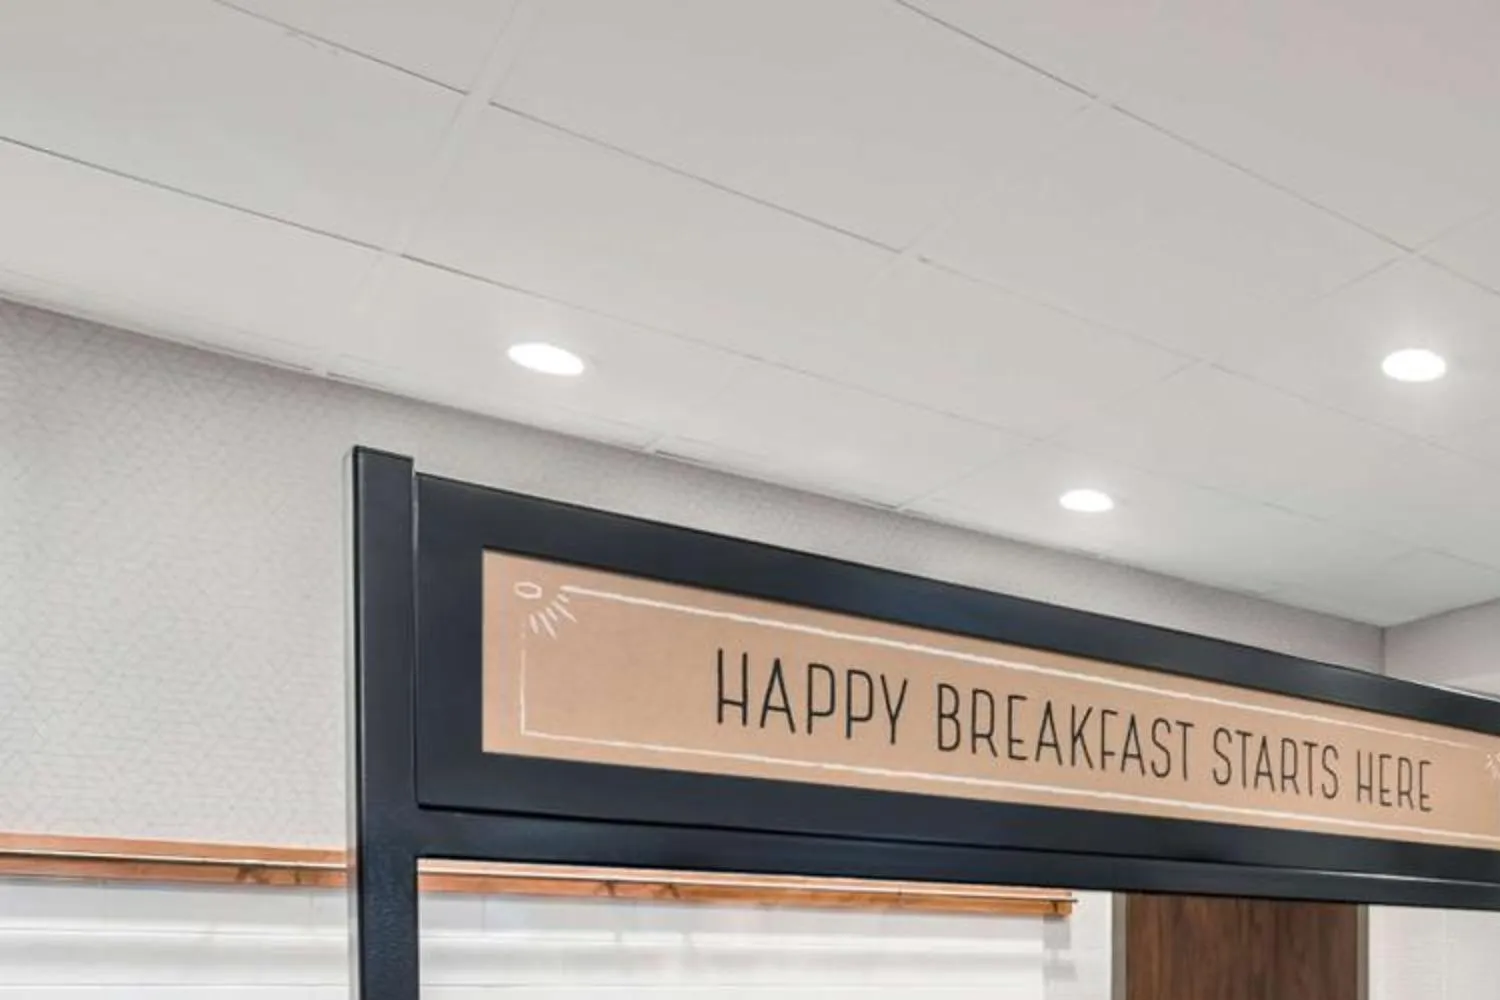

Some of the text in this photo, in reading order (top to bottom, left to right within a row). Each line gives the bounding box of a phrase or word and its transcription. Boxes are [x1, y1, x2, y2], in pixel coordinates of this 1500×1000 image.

[715, 648, 1434, 812] HAPPY BREAKFAST STARTS HERE
